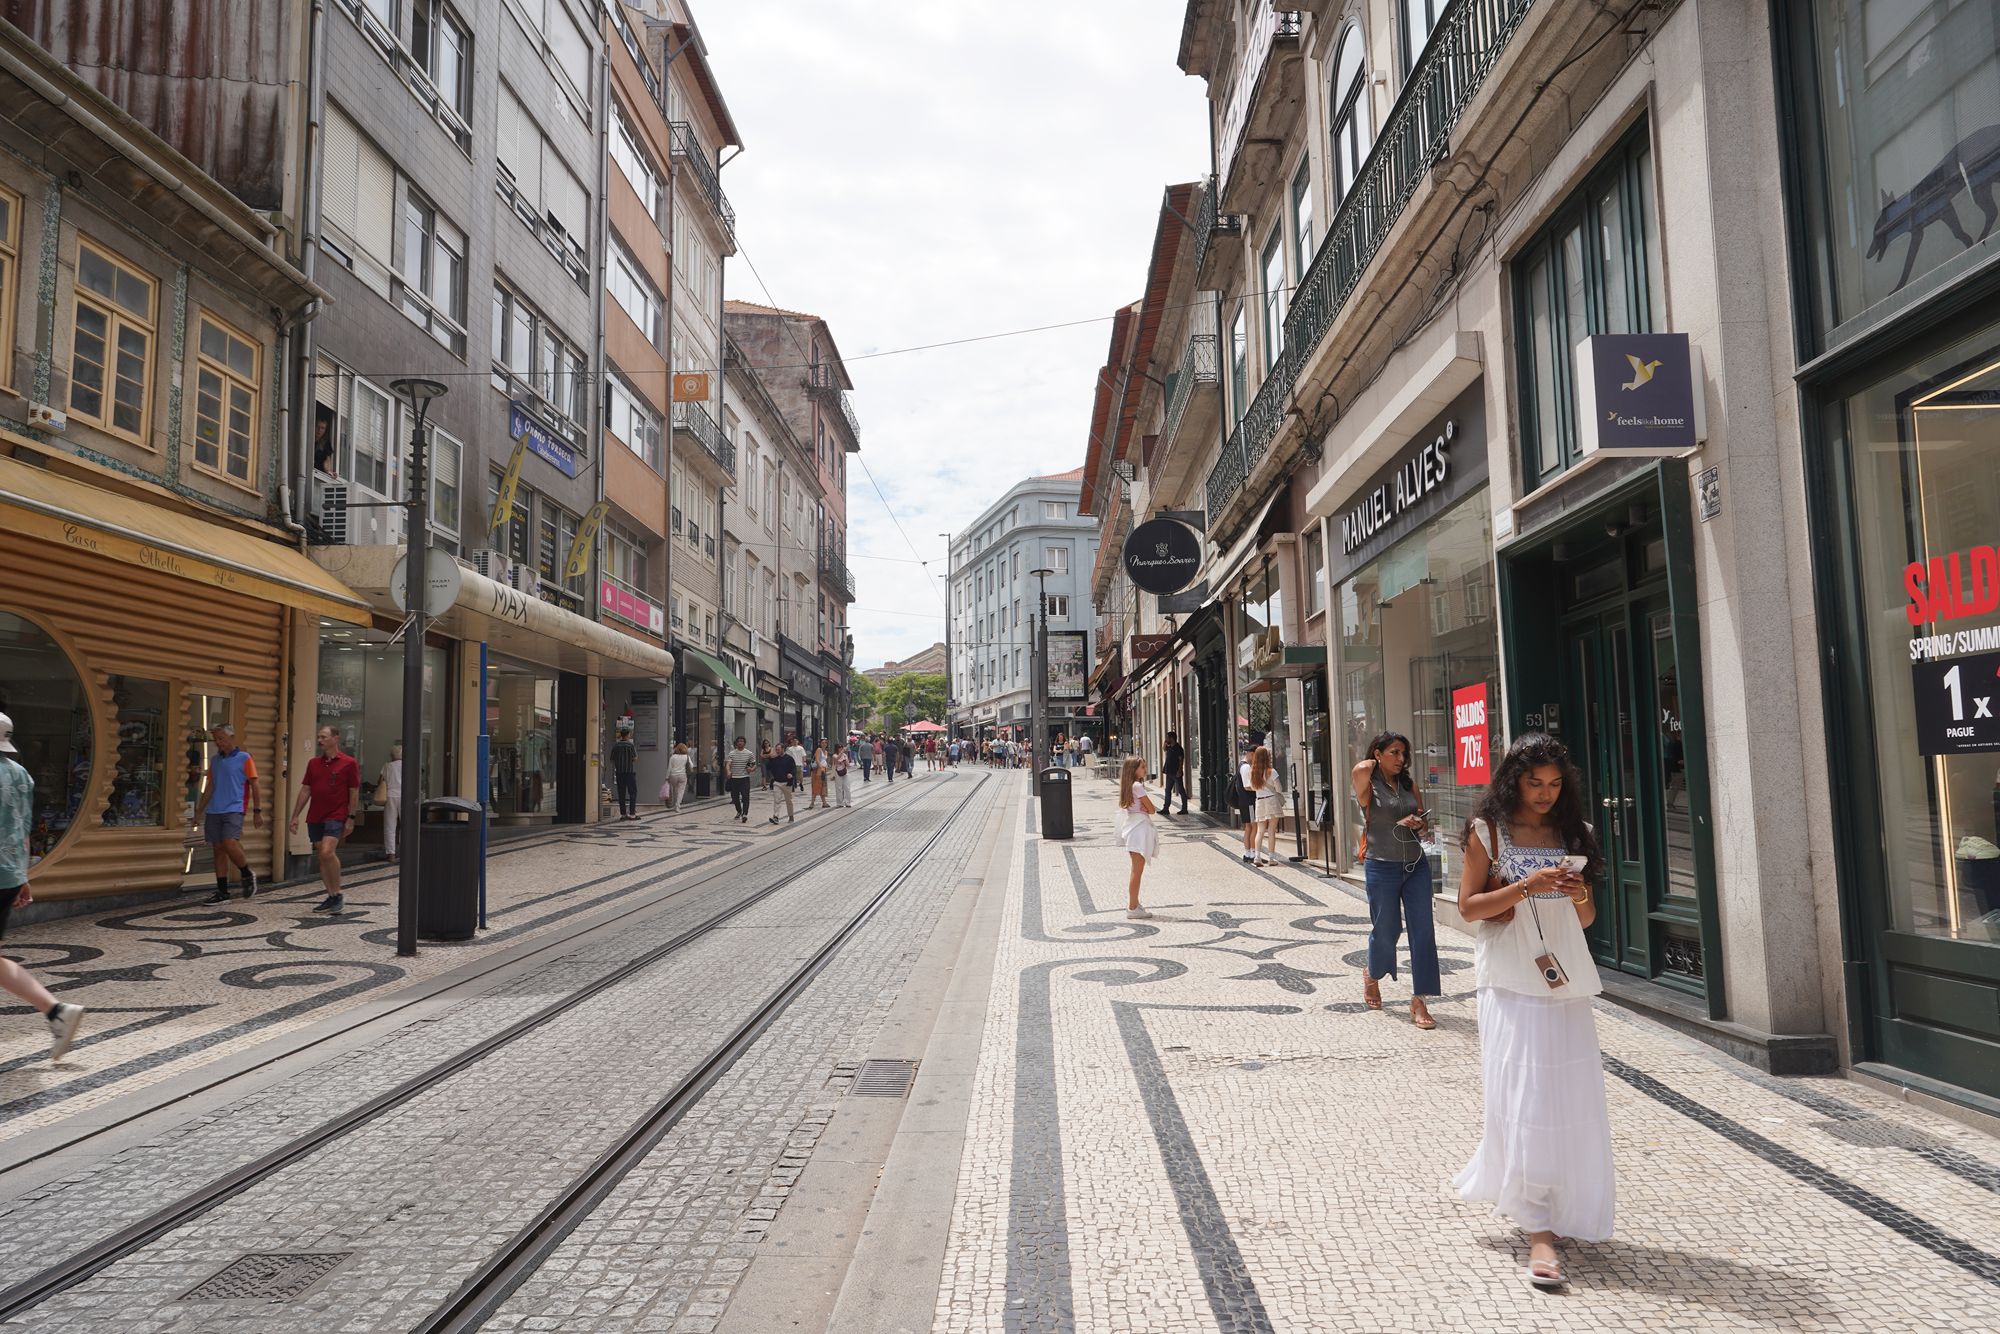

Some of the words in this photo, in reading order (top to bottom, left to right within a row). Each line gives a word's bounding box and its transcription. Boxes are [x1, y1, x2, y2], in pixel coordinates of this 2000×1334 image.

[496, 441, 524, 523] OURO
[1342, 484, 1392, 555] MANUEL
[62, 522, 97, 550] Casa
[569, 505, 602, 575] OURO
[1130, 554, 1167, 568] Marques
[1167, 555, 1196, 565] Soares
[491, 582, 528, 621] MAX
[316, 692, 352, 709] ROMOÇÕES
[1943, 665, 1963, 721] 1
[1455, 699, 1486, 729] SALDOS
[1526, 713, 1543, 727] 53
[1946, 726, 1975, 738] PAGUE
[1460, 734, 1484, 769] 70%
